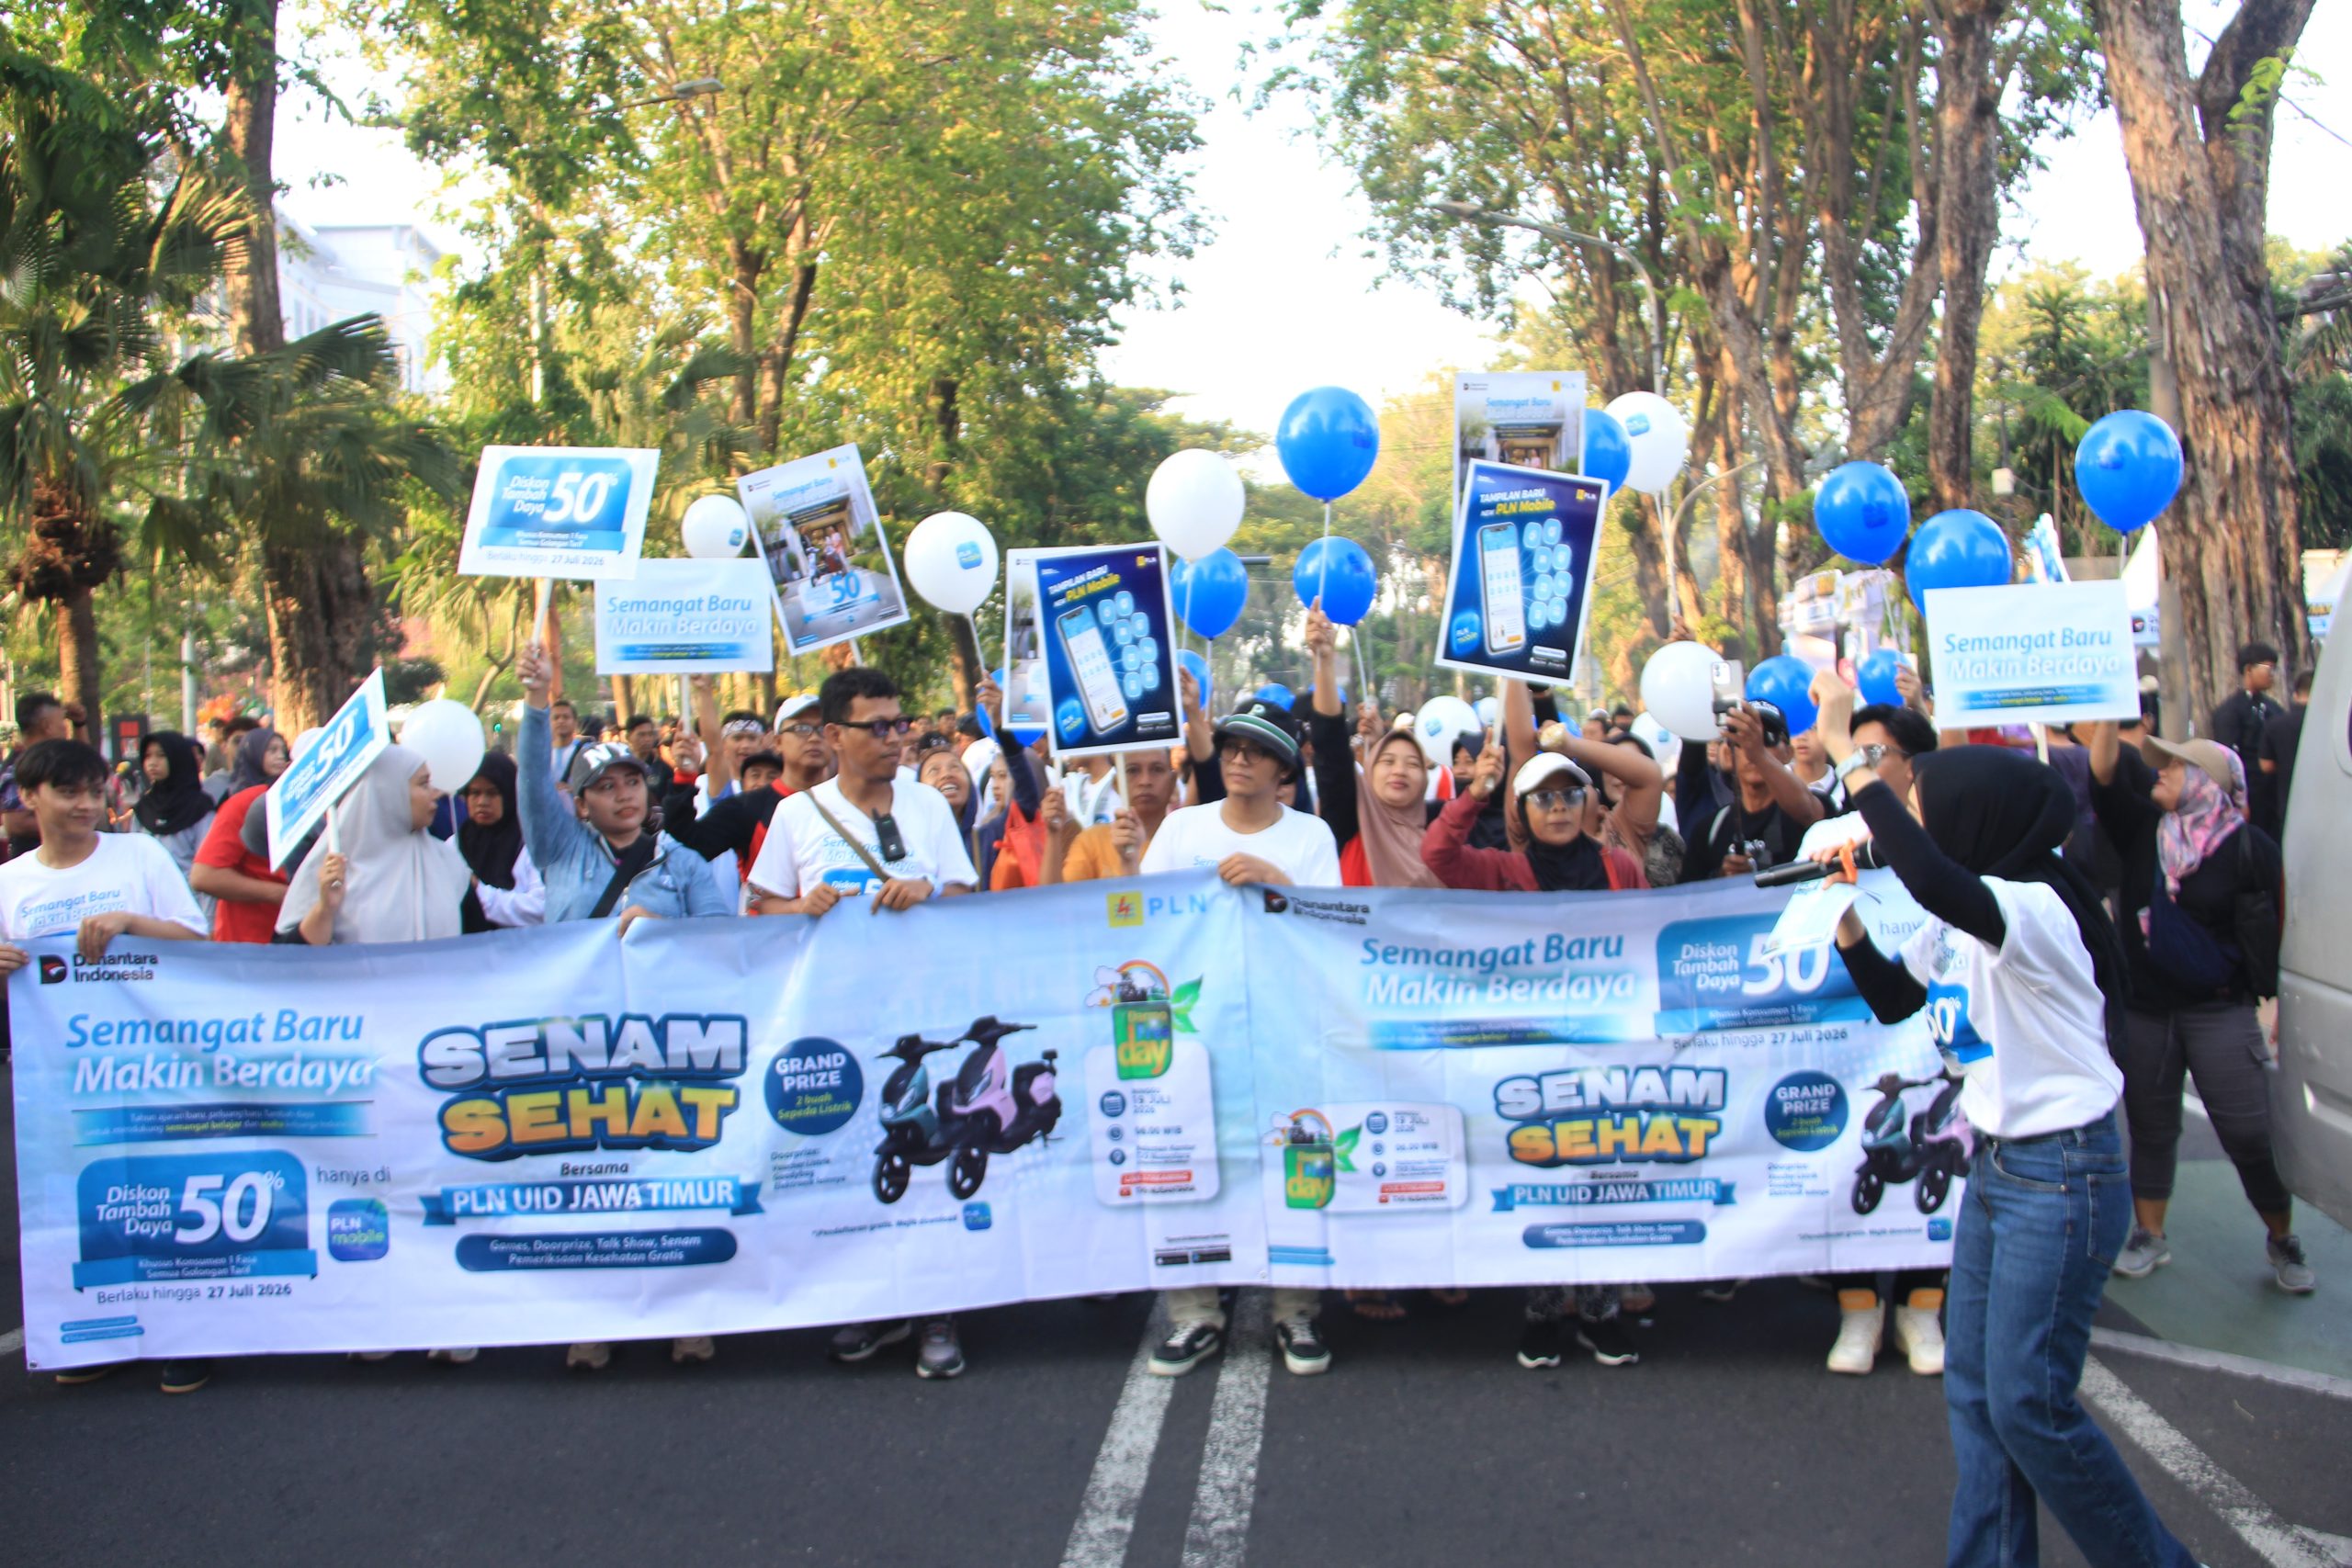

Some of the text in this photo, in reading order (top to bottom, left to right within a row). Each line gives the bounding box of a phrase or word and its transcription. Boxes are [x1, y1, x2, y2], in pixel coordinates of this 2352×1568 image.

[510, 475, 551, 489] Diskon
[502, 487, 548, 500] Tambah
[1479, 488, 1546, 503] TAMPILAN BARU
[514, 500, 546, 517] Daya
[1496, 502, 1518, 514] PLN
[1519, 498, 1556, 513] Mobile
[551, 555, 562, 565] 27
[564, 555, 581, 566] Juli
[582, 556, 605, 566] 2026
[831, 571, 860, 604] 50
[1066, 584, 1086, 602] PLN
[607, 595, 752, 616] Semangat Baru
[611, 615, 757, 637] Makin Berdaya
[1944, 626, 2112, 655] Semangat Baru
[1950, 652, 2120, 680] Makin Berdaya
[582, 742, 631, 770] NY
[21, 888, 120, 917] Semangat Baru
[1148, 894, 1207, 917] PLN
[1361, 932, 1624, 975] Semangat Baru
[1681, 942, 1739, 960] Diskon
[74, 966, 154, 983] Indonesia
[1672, 956, 1739, 976] Tambah
[1366, 967, 1635, 1006] Makin Berdaya
[1696, 973, 1741, 993] Daya
[66, 1008, 365, 1052] Semangat Baru
[1721, 1032, 1766, 1049] hingga
[1770, 1032, 1786, 1043] 27
[1791, 1030, 1813, 1043] Juli
[1816, 1028, 1849, 1042] 2026
[421, 1014, 745, 1088] SENAM
[73, 1049, 372, 1096] Makin Berdaya
[775, 1052, 847, 1076] GRAND
[783, 1069, 842, 1093] PRIZE
[796, 1091, 833, 1107] 2 buah
[1495, 1066, 1725, 1119] SENAM
[1776, 1083, 1837, 1100] GRAND
[1782, 1098, 1831, 1115] PRIZE
[441, 1084, 737, 1155] SEHAT
[1510, 1115, 1720, 1162] SEHAT
[316, 1165, 391, 1186] hanya di
[560, 1160, 629, 1177] Bersama
[1589, 1170, 1639, 1179] Bersama
[106, 1185, 171, 1204] Diskon
[452, 1179, 734, 1213] PLN UID JAWA TIMUR
[1515, 1180, 1717, 1204] PLN UID JAWA TIMUR
[96, 1201, 172, 1223] Tambah
[125, 1219, 173, 1238] Daya
[330, 1217, 362, 1232] PLN
[332, 1228, 386, 1247] mobile
[489, 1238, 531, 1252] Games,
[533, 1237, 594, 1254] Doorprize,
[596, 1236, 621, 1250] Talk
[660, 1234, 702, 1247] Senam
[175, 1257, 227, 1268] Konsumen
[508, 1248, 684, 1266] Pemeriksaan Kesehatan Gratis
[147, 1264, 252, 1279] Semua Golongan Tarif
[96, 1283, 292, 1304] Berlaku hingga 27 Juli 2026
